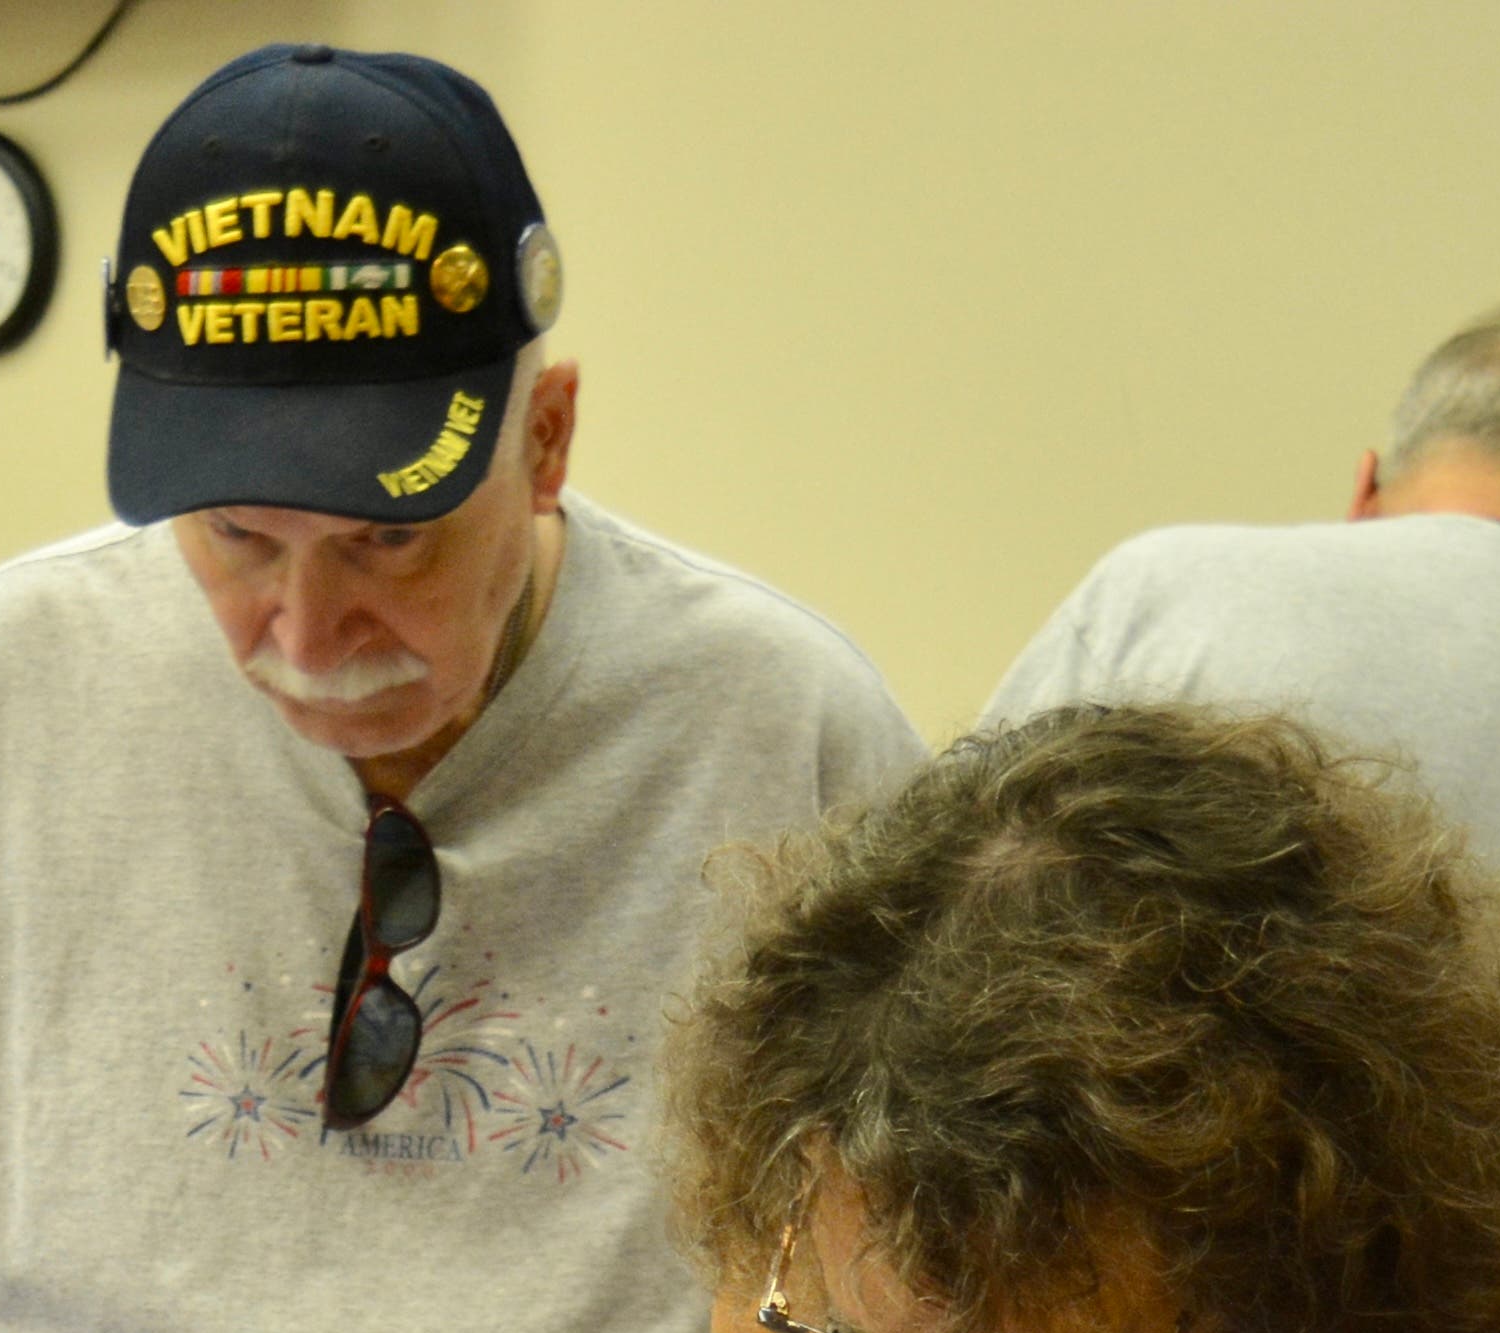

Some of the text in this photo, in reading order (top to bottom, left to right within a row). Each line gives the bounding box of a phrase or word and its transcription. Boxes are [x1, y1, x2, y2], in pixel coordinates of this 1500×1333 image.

[152, 188, 437, 267] VIETNAM
[177, 295, 418, 346] VETERAN
[376, 390, 485, 498] VIETNAM VET
[341, 1132, 465, 1162] AMERICA
